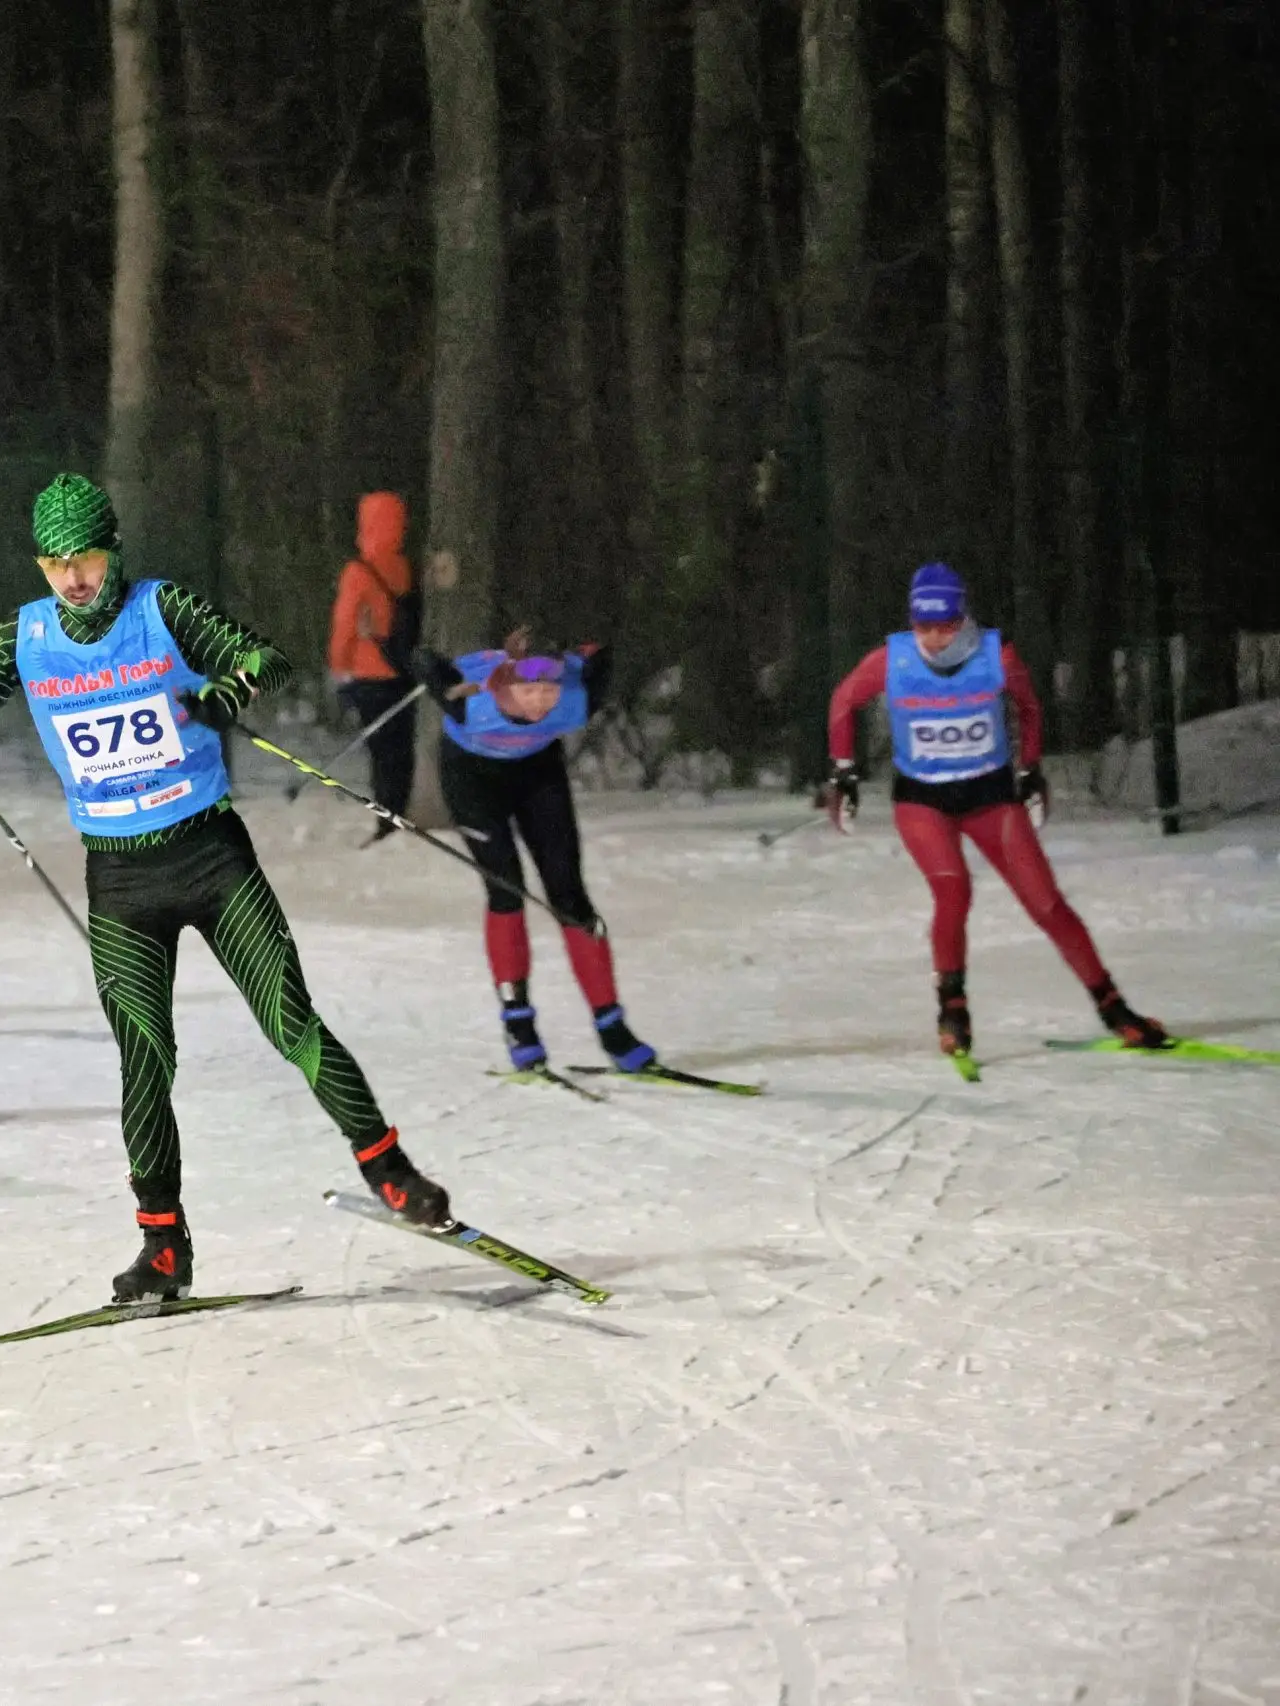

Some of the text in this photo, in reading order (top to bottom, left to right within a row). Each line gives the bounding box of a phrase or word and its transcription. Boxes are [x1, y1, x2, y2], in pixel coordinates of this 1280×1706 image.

[118, 654, 174, 686] ГОРЫ
[48, 683, 163, 711] ЛЫЖНЫЙ ФЕСТИВАЛЬ
[67, 709, 164, 758] 678
[83, 750, 165, 774] НОЧНАЯ ГОНКА
